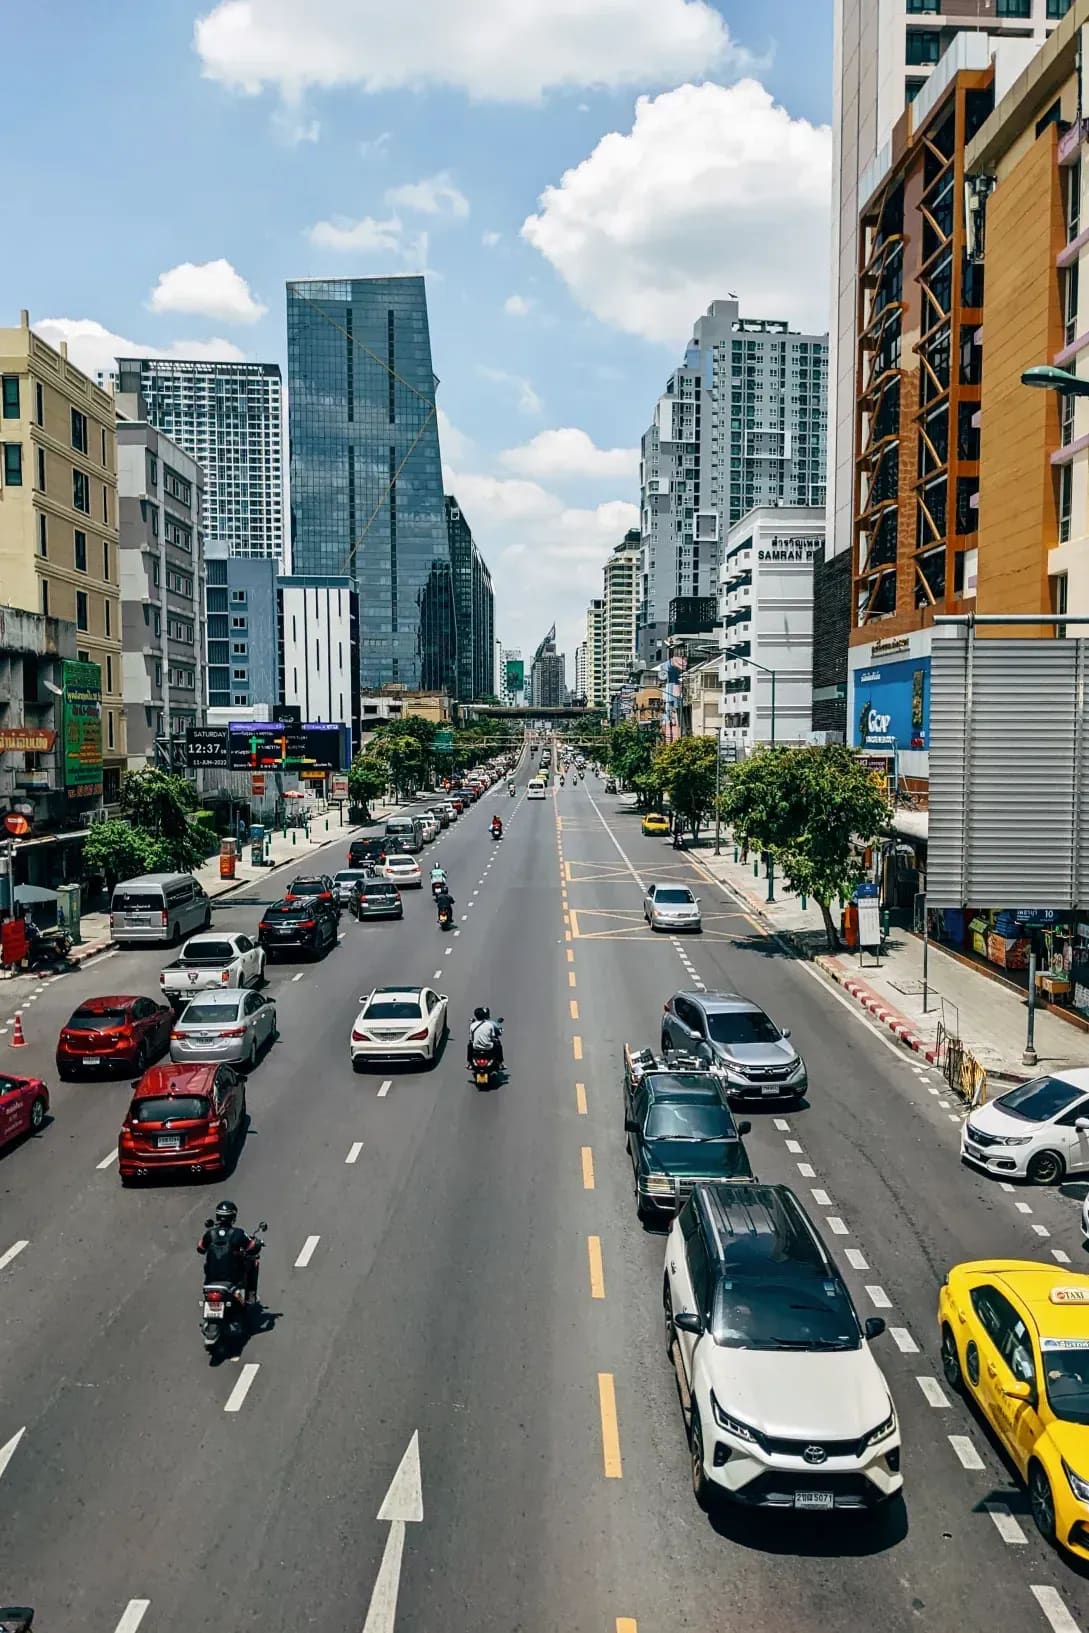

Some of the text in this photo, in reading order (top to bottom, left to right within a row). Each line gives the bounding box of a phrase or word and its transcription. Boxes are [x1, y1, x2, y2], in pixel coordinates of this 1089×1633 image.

[758, 550, 802, 560] SAMRAN
[188, 743, 220, 754] 12:37
[1064, 1291, 1085, 1299] TAXI
[814, 1493, 832, 1503] 5071
